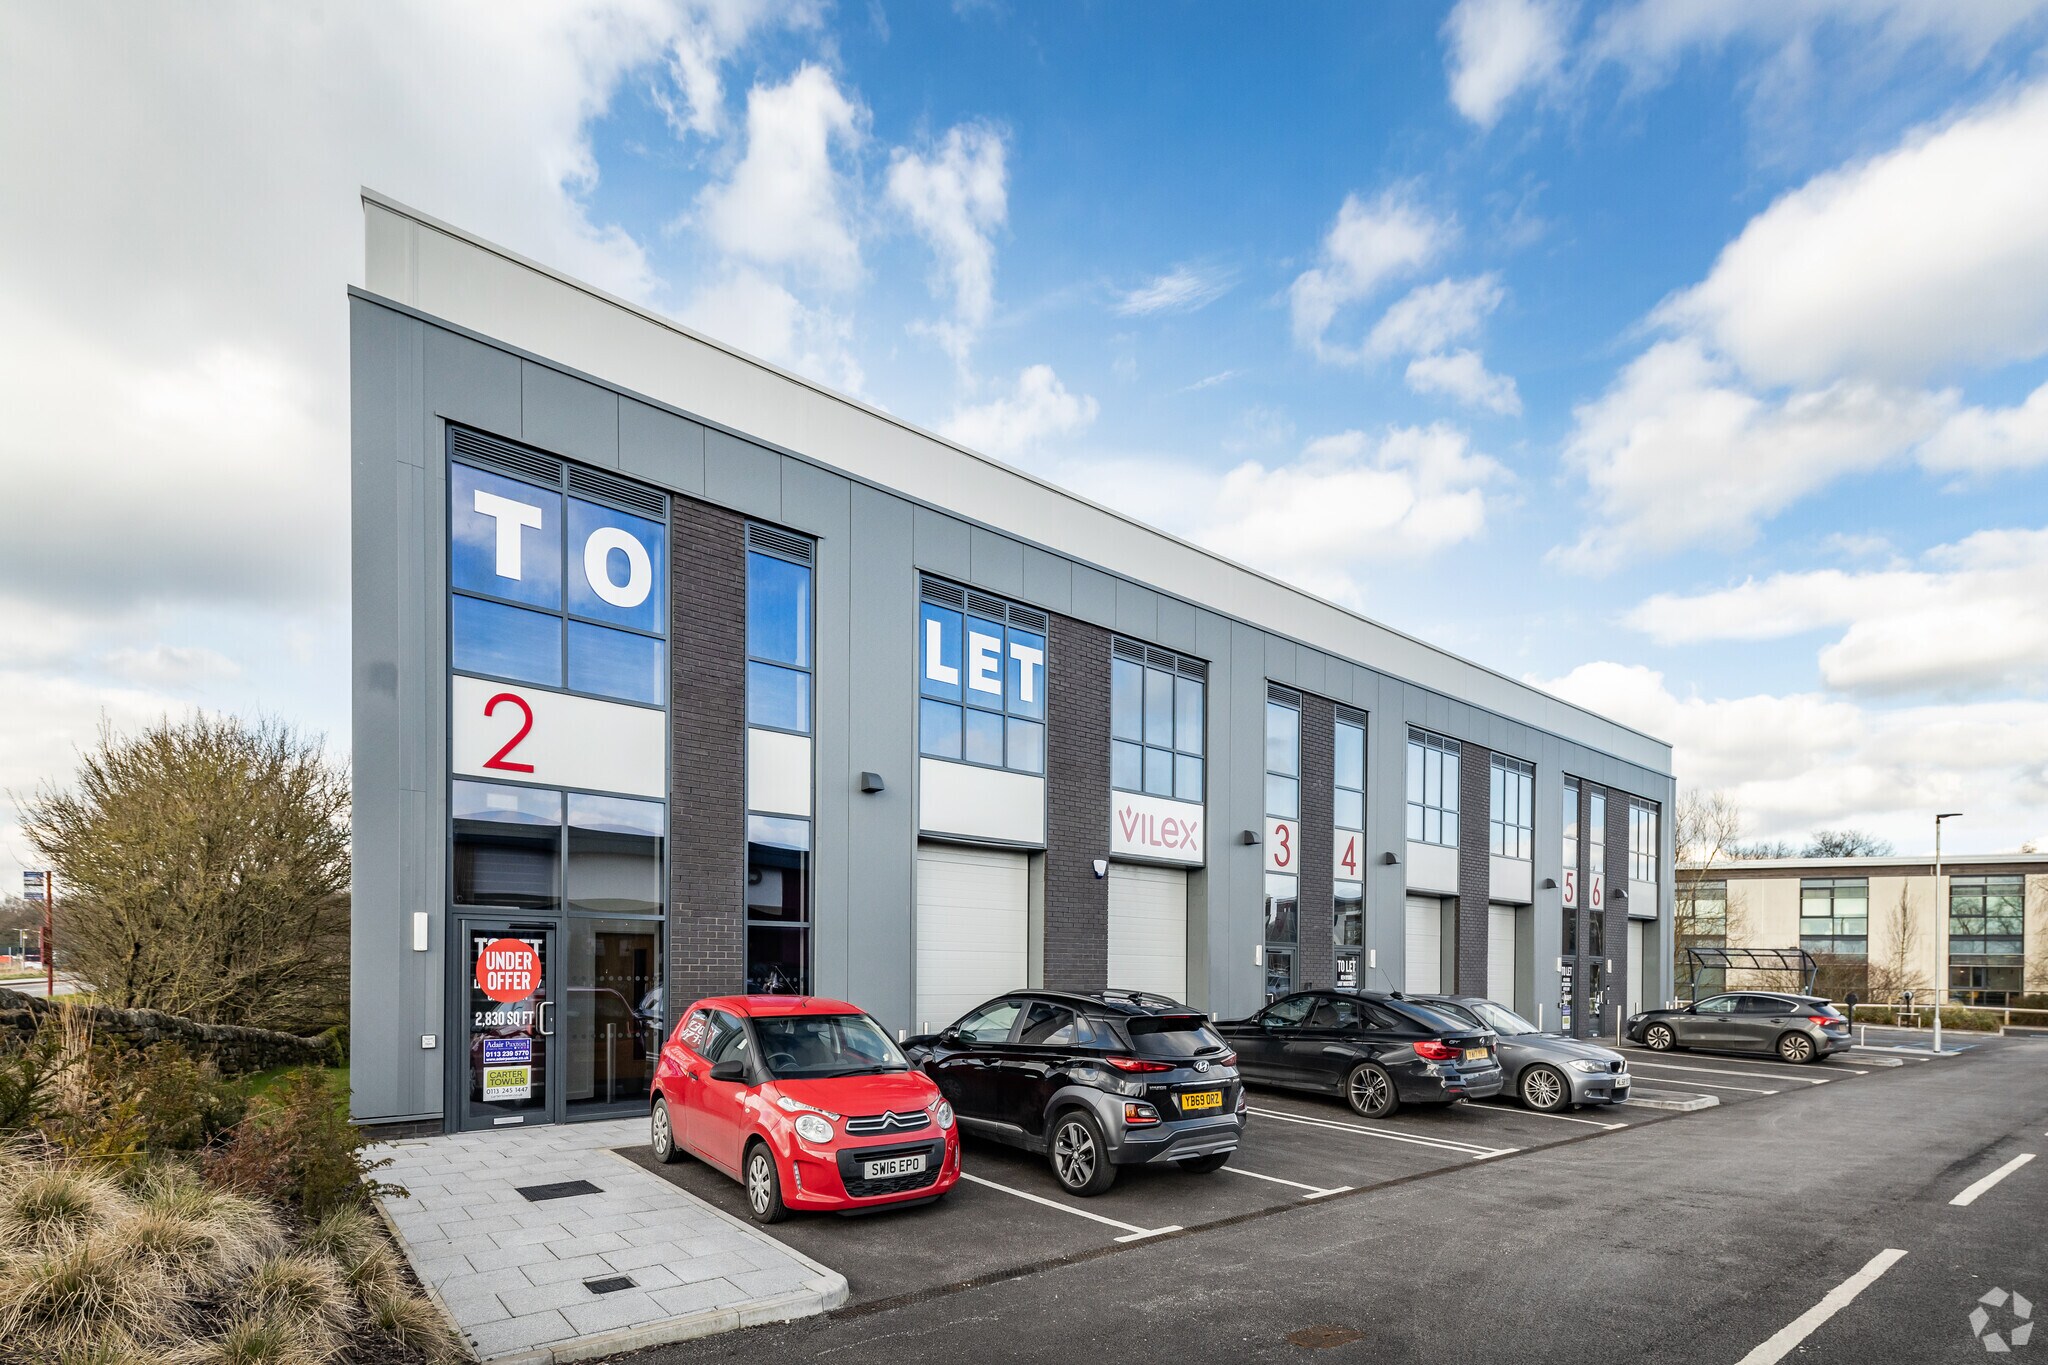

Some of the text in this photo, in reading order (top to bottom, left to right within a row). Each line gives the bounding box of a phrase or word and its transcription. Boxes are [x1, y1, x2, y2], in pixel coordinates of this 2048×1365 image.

[474, 489, 1043, 703] TO LET
[482, 692, 534, 774] 2
[1274, 824, 1290, 867] 3
[1341, 835, 1356, 876] 4
[1565, 872, 1573, 903] 5
[1593, 877, 1600, 906] 6
[485, 951, 533, 970] UNDER
[1337, 960, 1356, 972] TO LET
[487, 971, 531, 991] OFFER
[475, 1010, 534, 1027] 2,830 SQ FT
[490, 1070, 522, 1079] CARTER
[490, 1078, 525, 1086] TOWLER
[1185, 1093, 1220, 1107] YB69 ORZ
[872, 1158, 919, 1176] SW16 EPO
